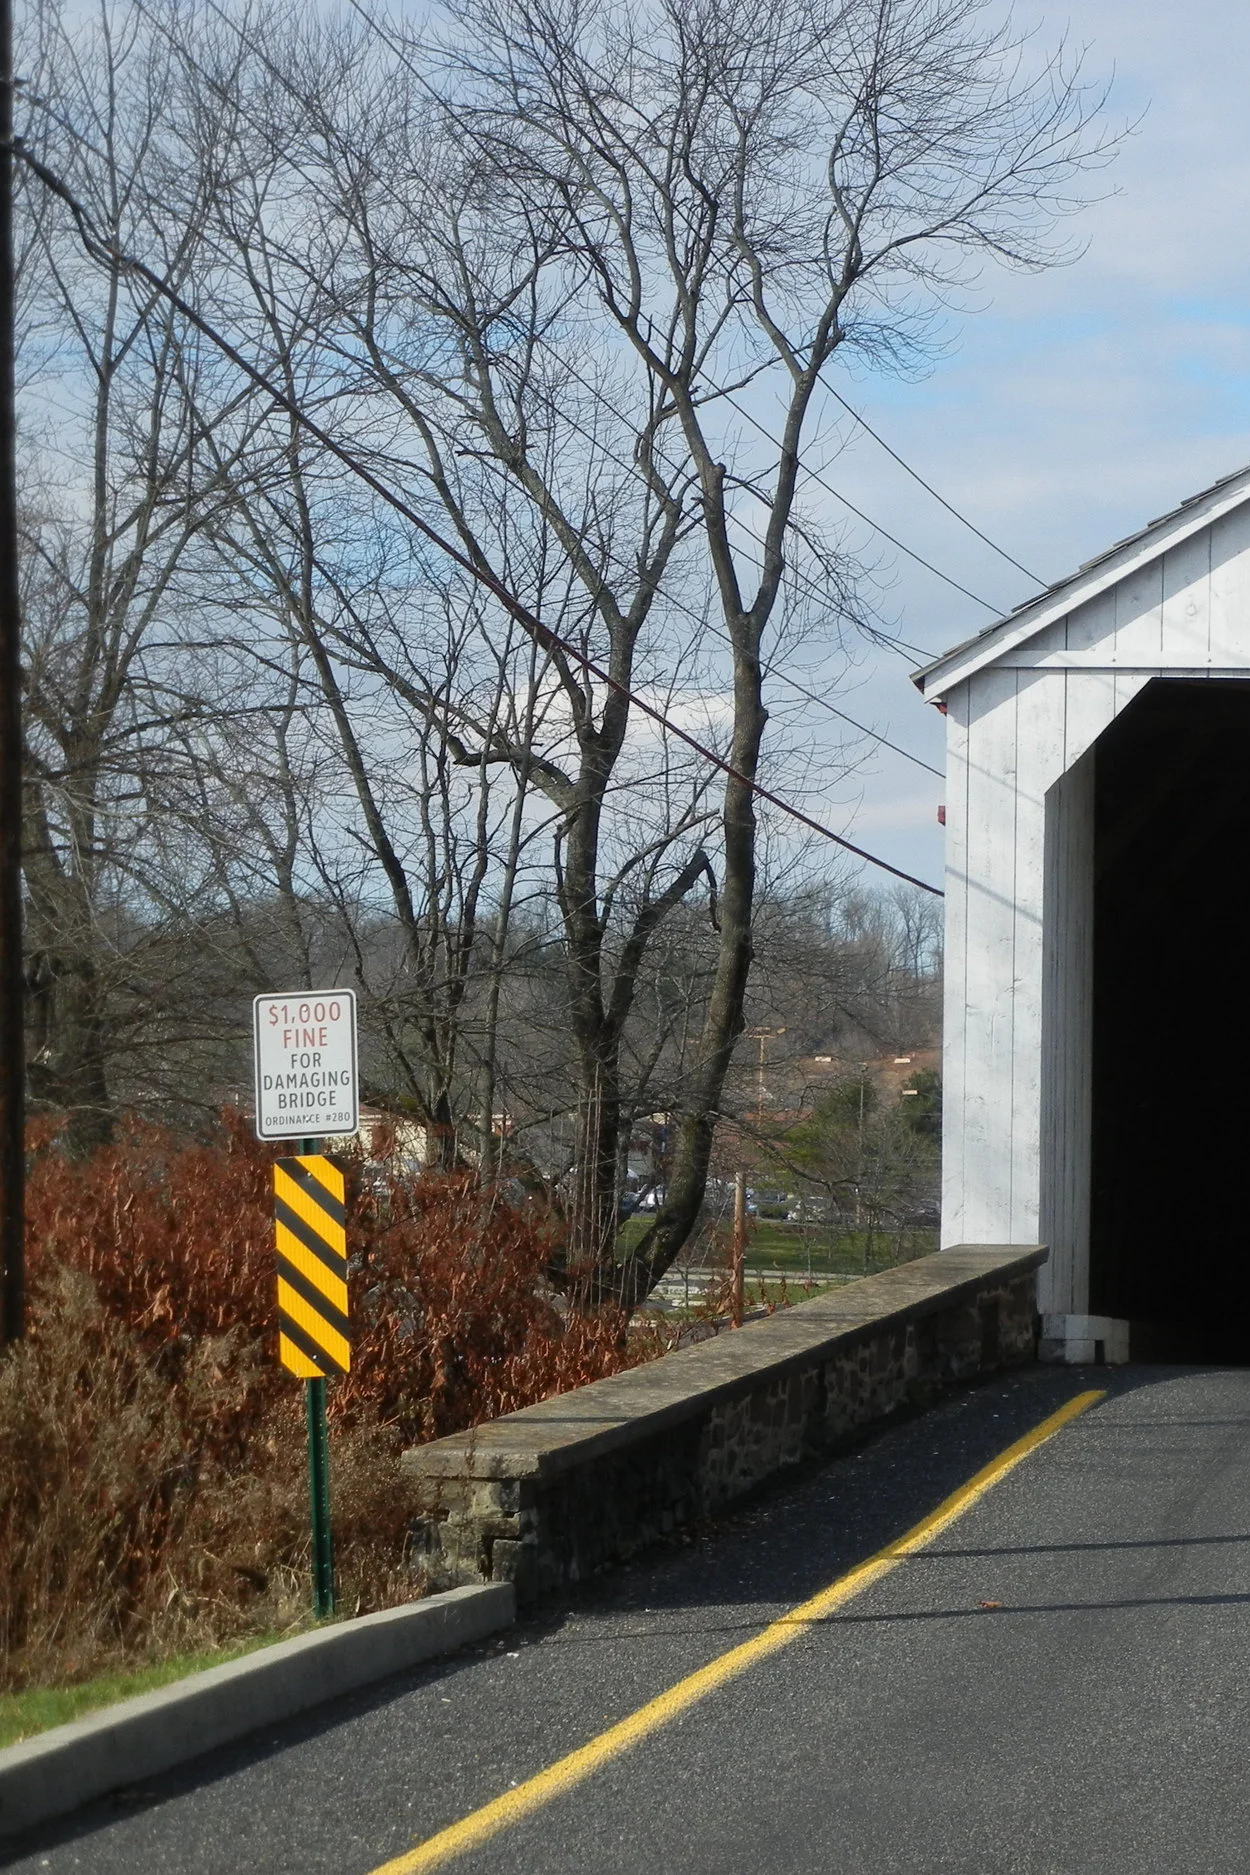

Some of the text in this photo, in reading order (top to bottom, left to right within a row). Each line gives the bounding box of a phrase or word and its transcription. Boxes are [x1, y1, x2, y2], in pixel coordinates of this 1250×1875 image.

[269, 1002, 340, 1026] $1,000
[284, 1027, 328, 1048] FINE
[291, 1052, 321, 1068] FOR
[264, 1070, 350, 1090] DAMAGING
[279, 1090, 336, 1109] BRIDGE
[265, 1112, 350, 1126] ORDINANCE #280
